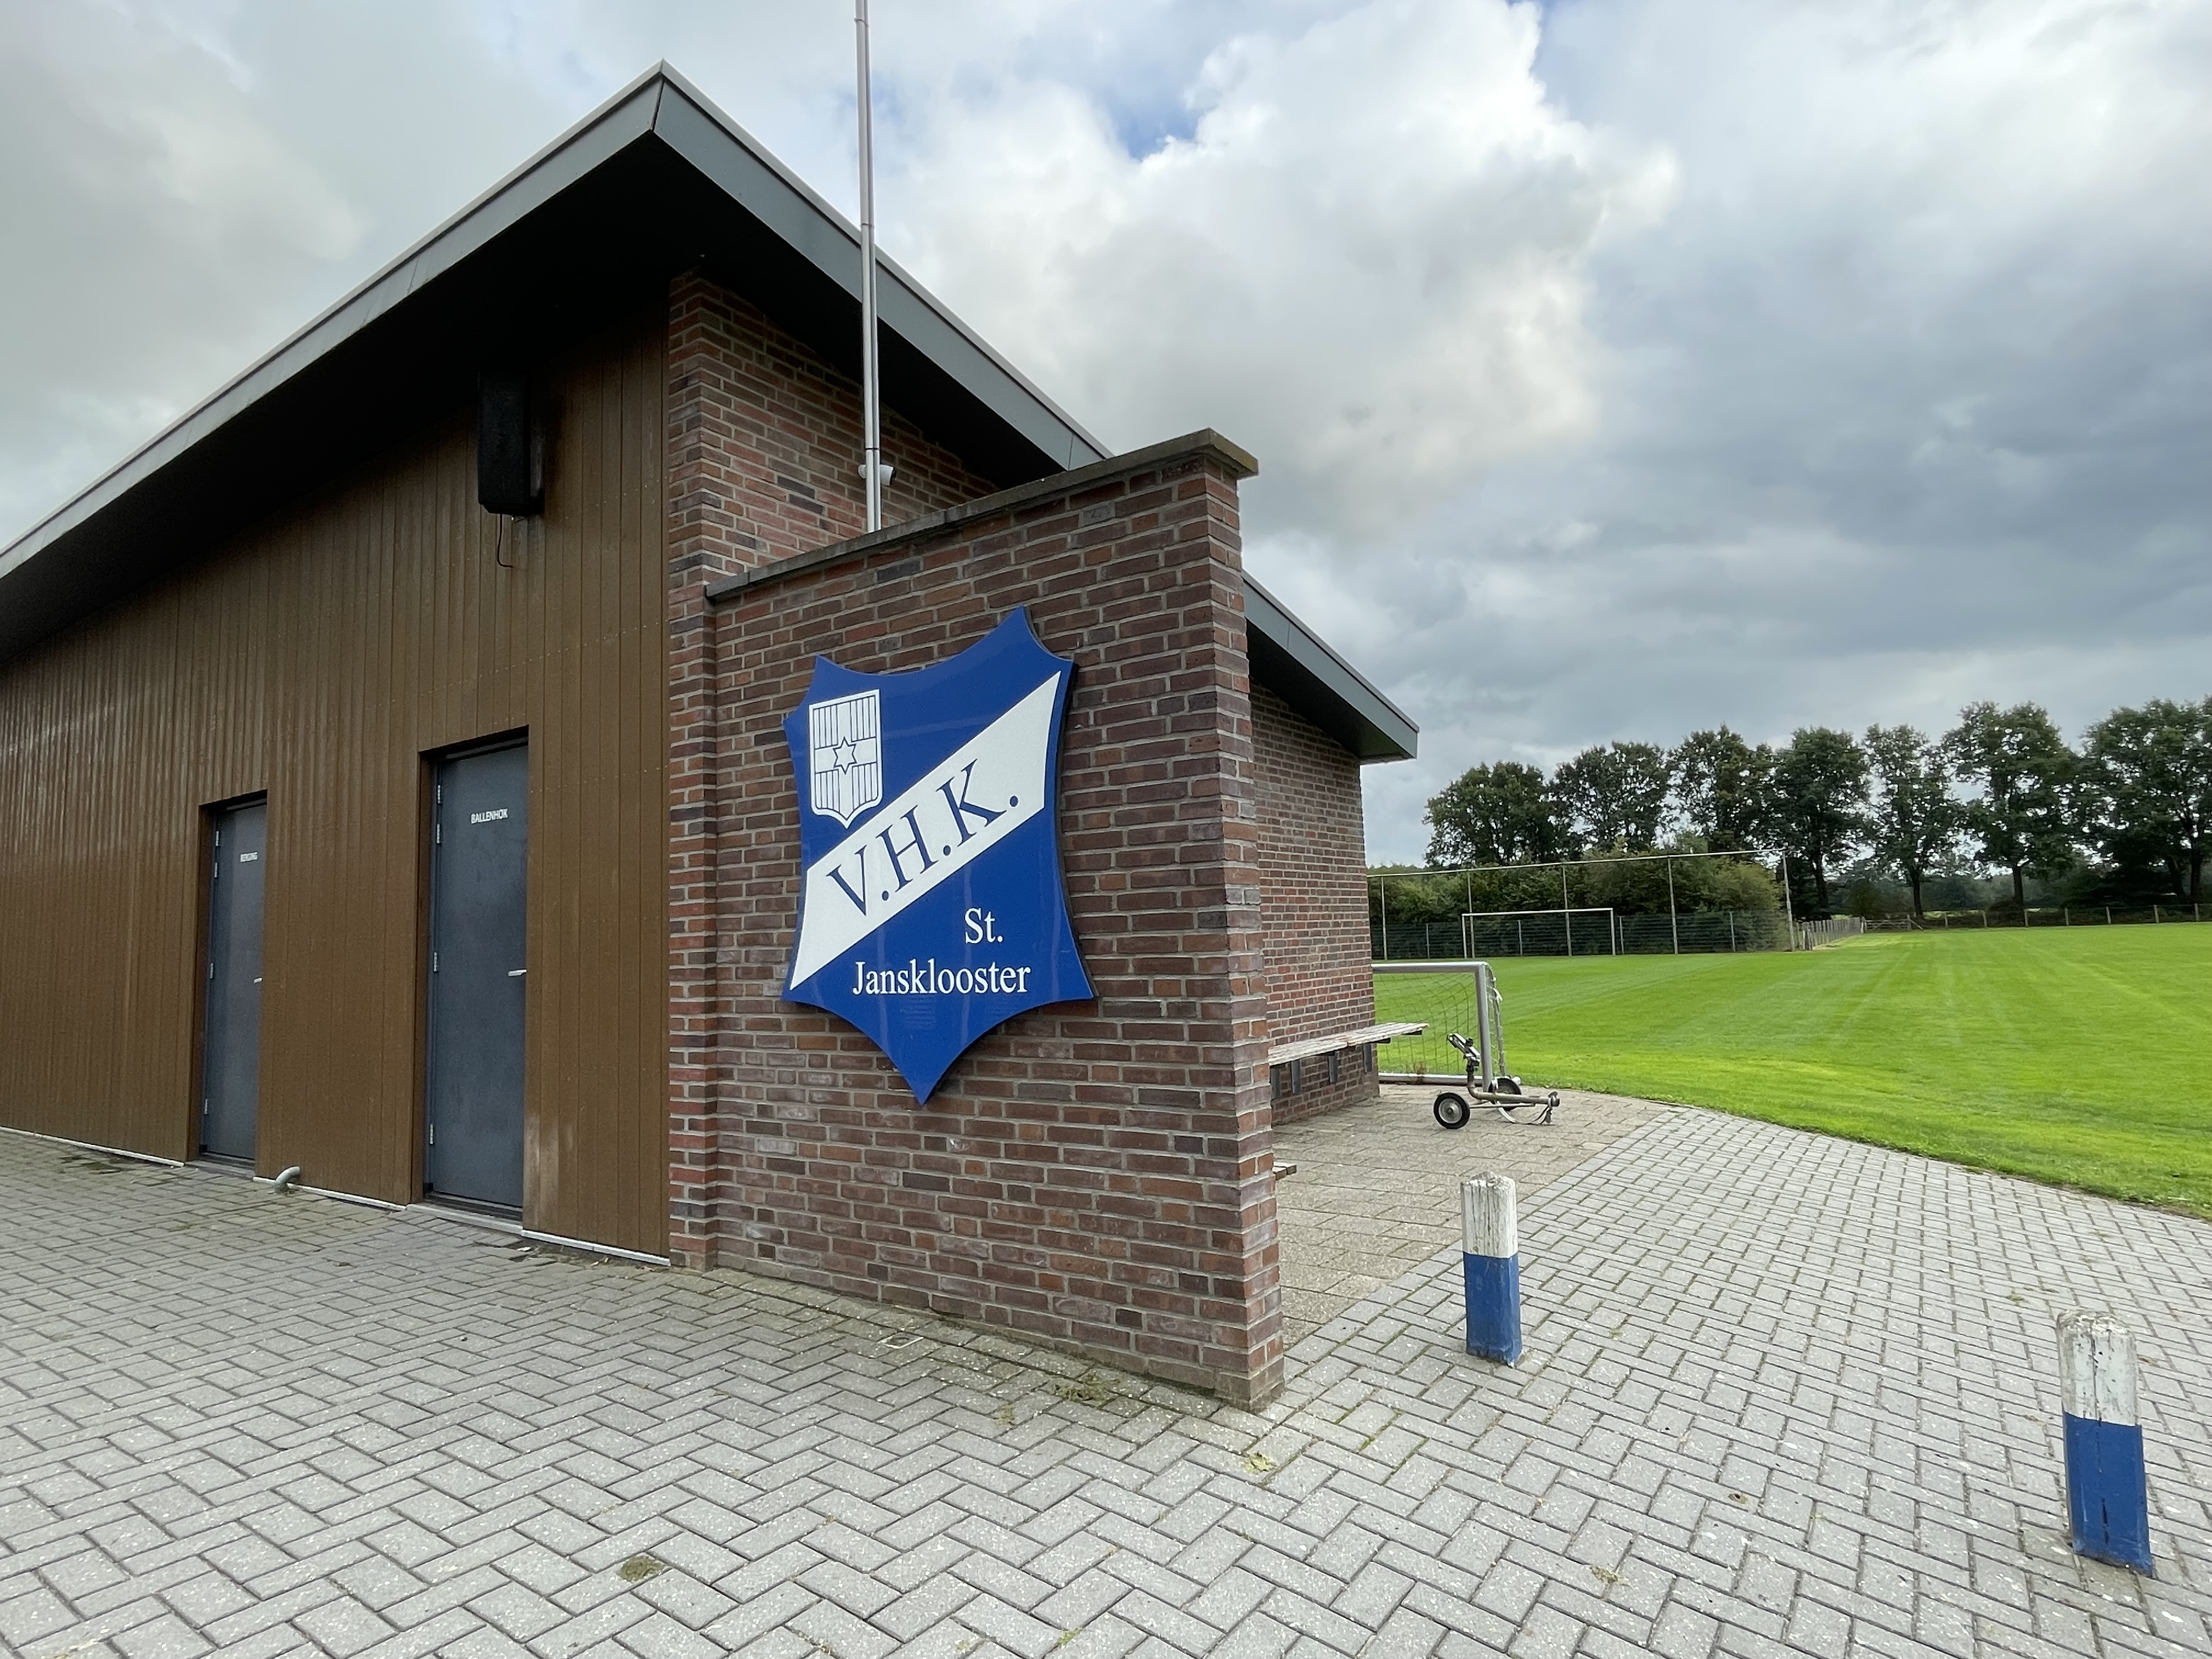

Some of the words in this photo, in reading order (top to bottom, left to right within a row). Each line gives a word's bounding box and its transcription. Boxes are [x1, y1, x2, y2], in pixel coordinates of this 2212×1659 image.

[471, 808, 508, 824] BALLENHOK
[826, 758, 1019, 916] V.H.K.
[964, 907, 1003, 944] St.
[852, 958, 1031, 995] Jansklooster
